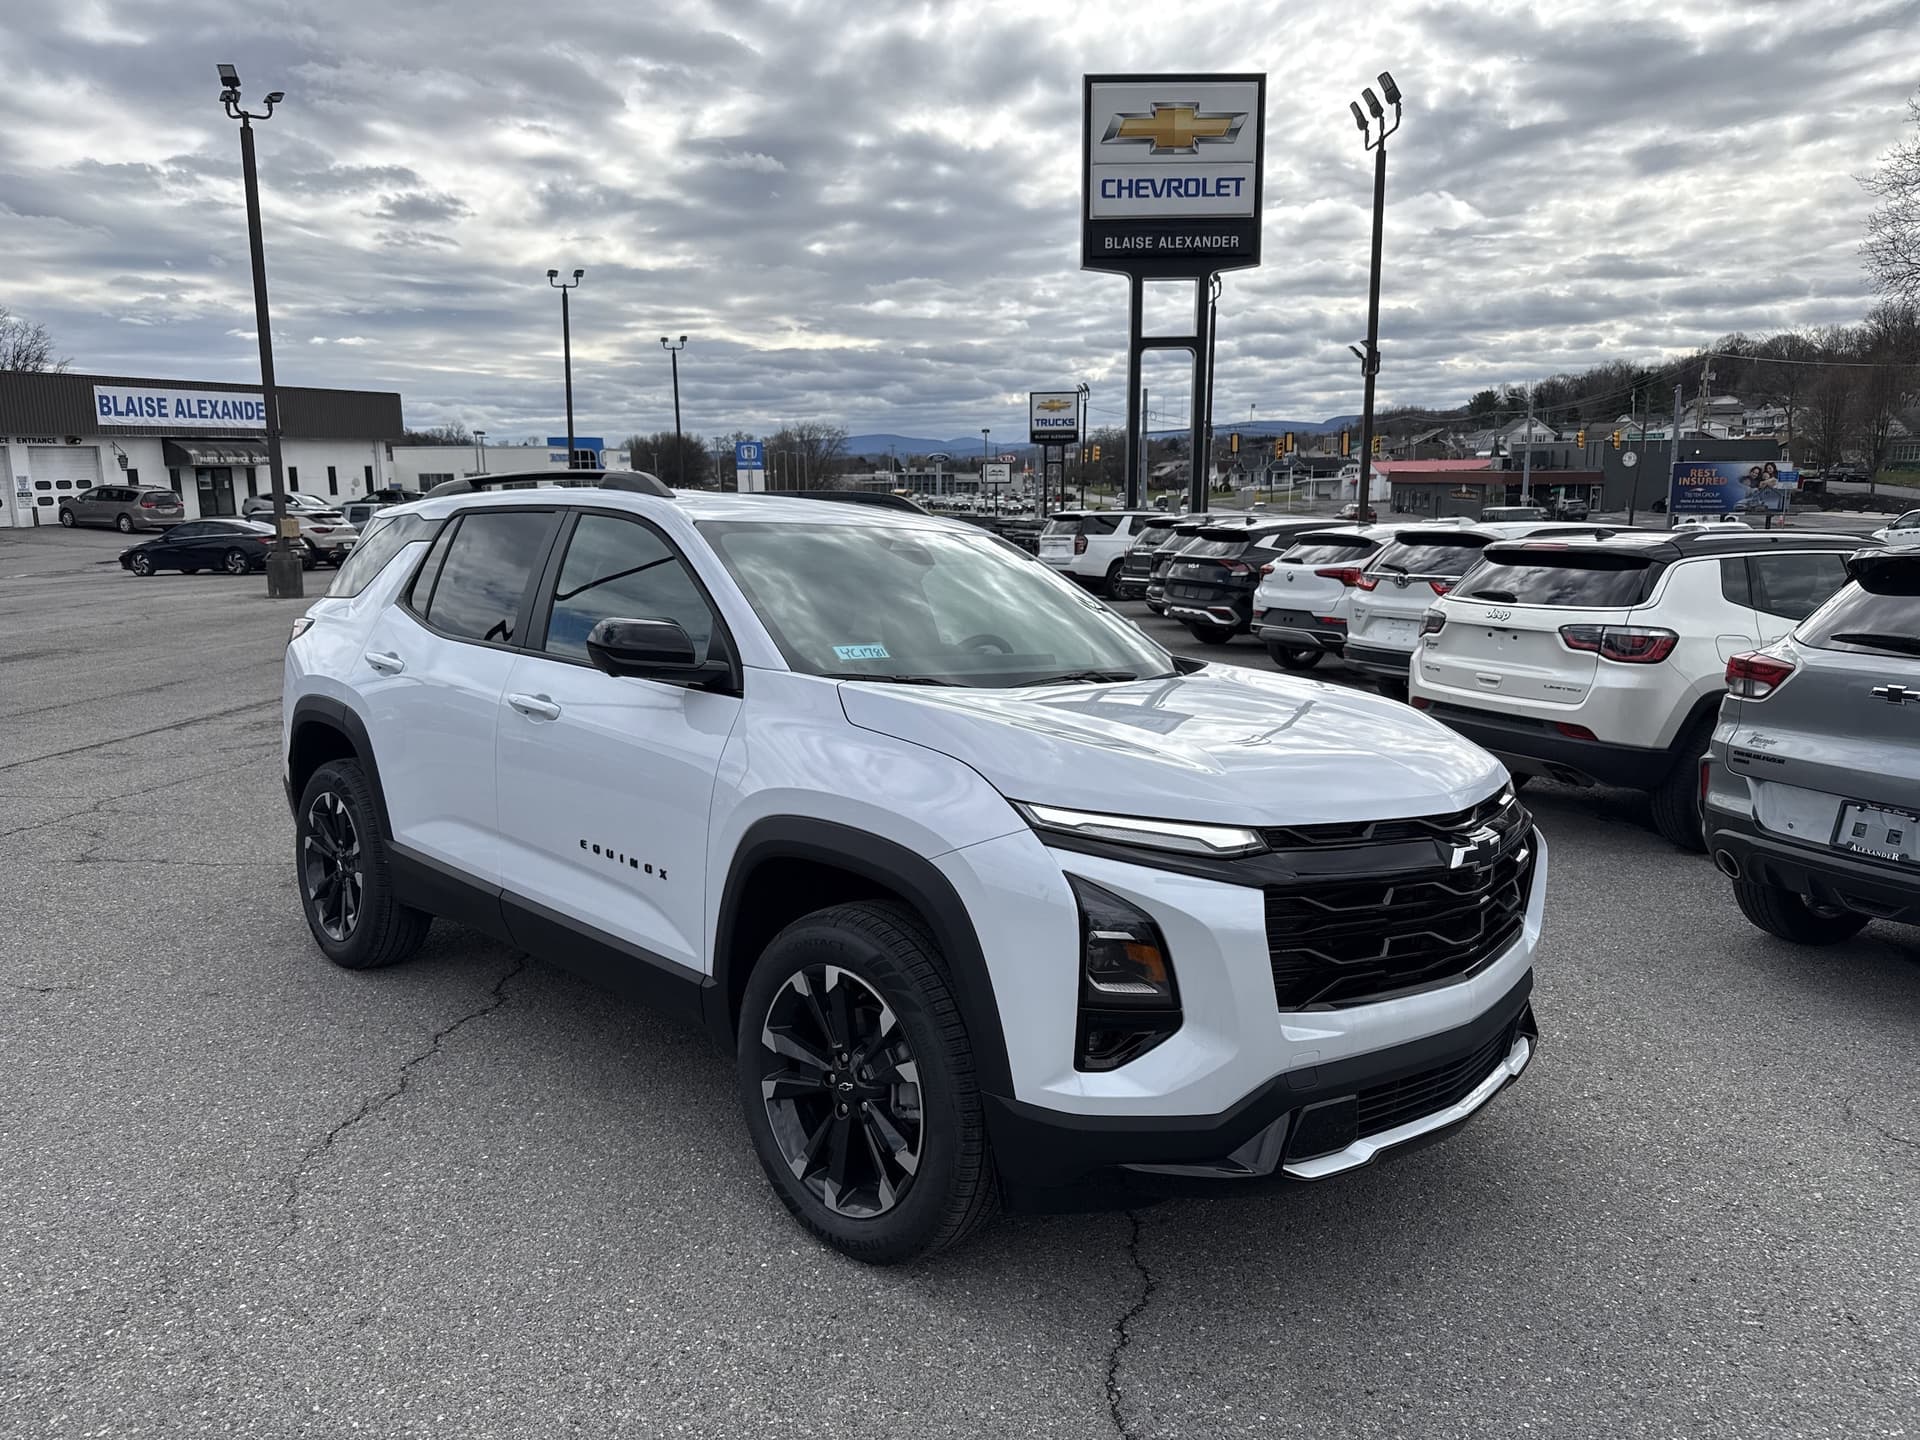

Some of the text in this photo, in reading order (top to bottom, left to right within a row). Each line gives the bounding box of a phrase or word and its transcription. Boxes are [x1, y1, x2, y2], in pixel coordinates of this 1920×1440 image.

[1101, 177, 1245, 199] CHEVROLET
[1104, 235, 1240, 249] BLAISE ALEXANDER
[98, 394, 265, 421] BLAISE ALEXANDE
[1035, 418, 1075, 427] TRUCKS
[1690, 468, 1718, 478] REST
[1678, 477, 1728, 486] INSURED
[1486, 608, 1511, 622] Jeep
[579, 839, 668, 881] EQUINOX
